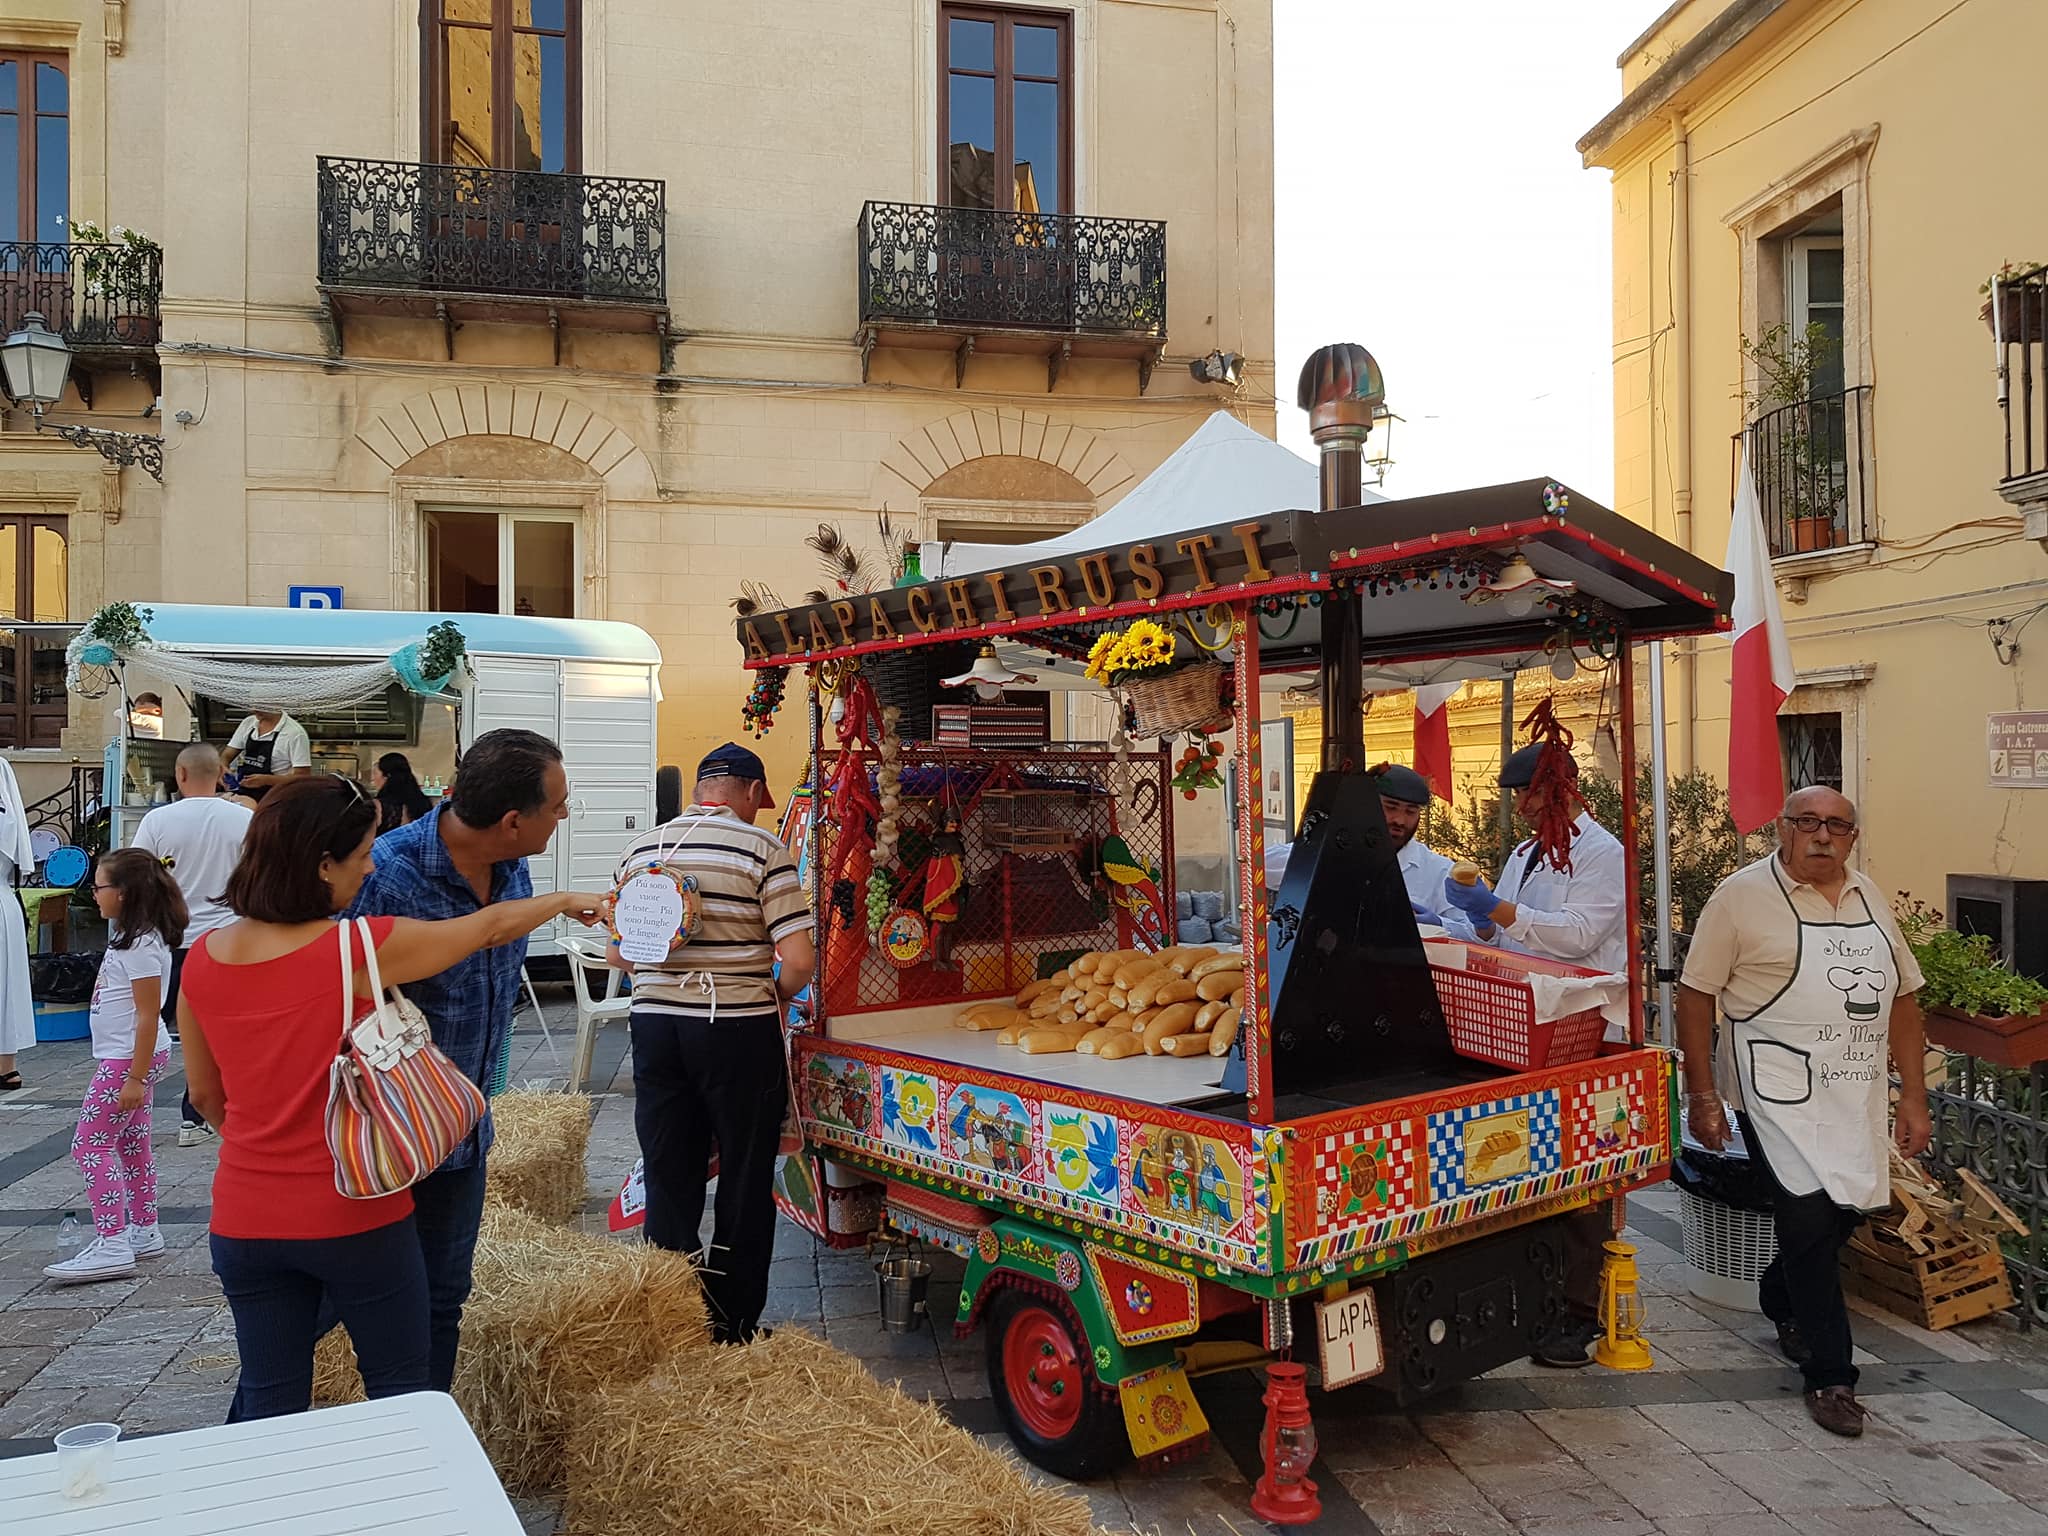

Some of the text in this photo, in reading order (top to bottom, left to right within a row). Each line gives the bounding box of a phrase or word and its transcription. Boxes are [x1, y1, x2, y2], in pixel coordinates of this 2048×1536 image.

[2006, 737, 2036, 748] I.A.T.
[624, 903, 631, 911] le
[624, 916, 670, 929] sono lunghe
[628, 927, 636, 936] le
[1823, 938, 1873, 957] Nino
[1816, 1024, 1841, 1041] il
[1842, 1045, 1873, 1062] dei
[1324, 1298, 1373, 1343] LAPA
[1348, 1341, 1356, 1372] 1
